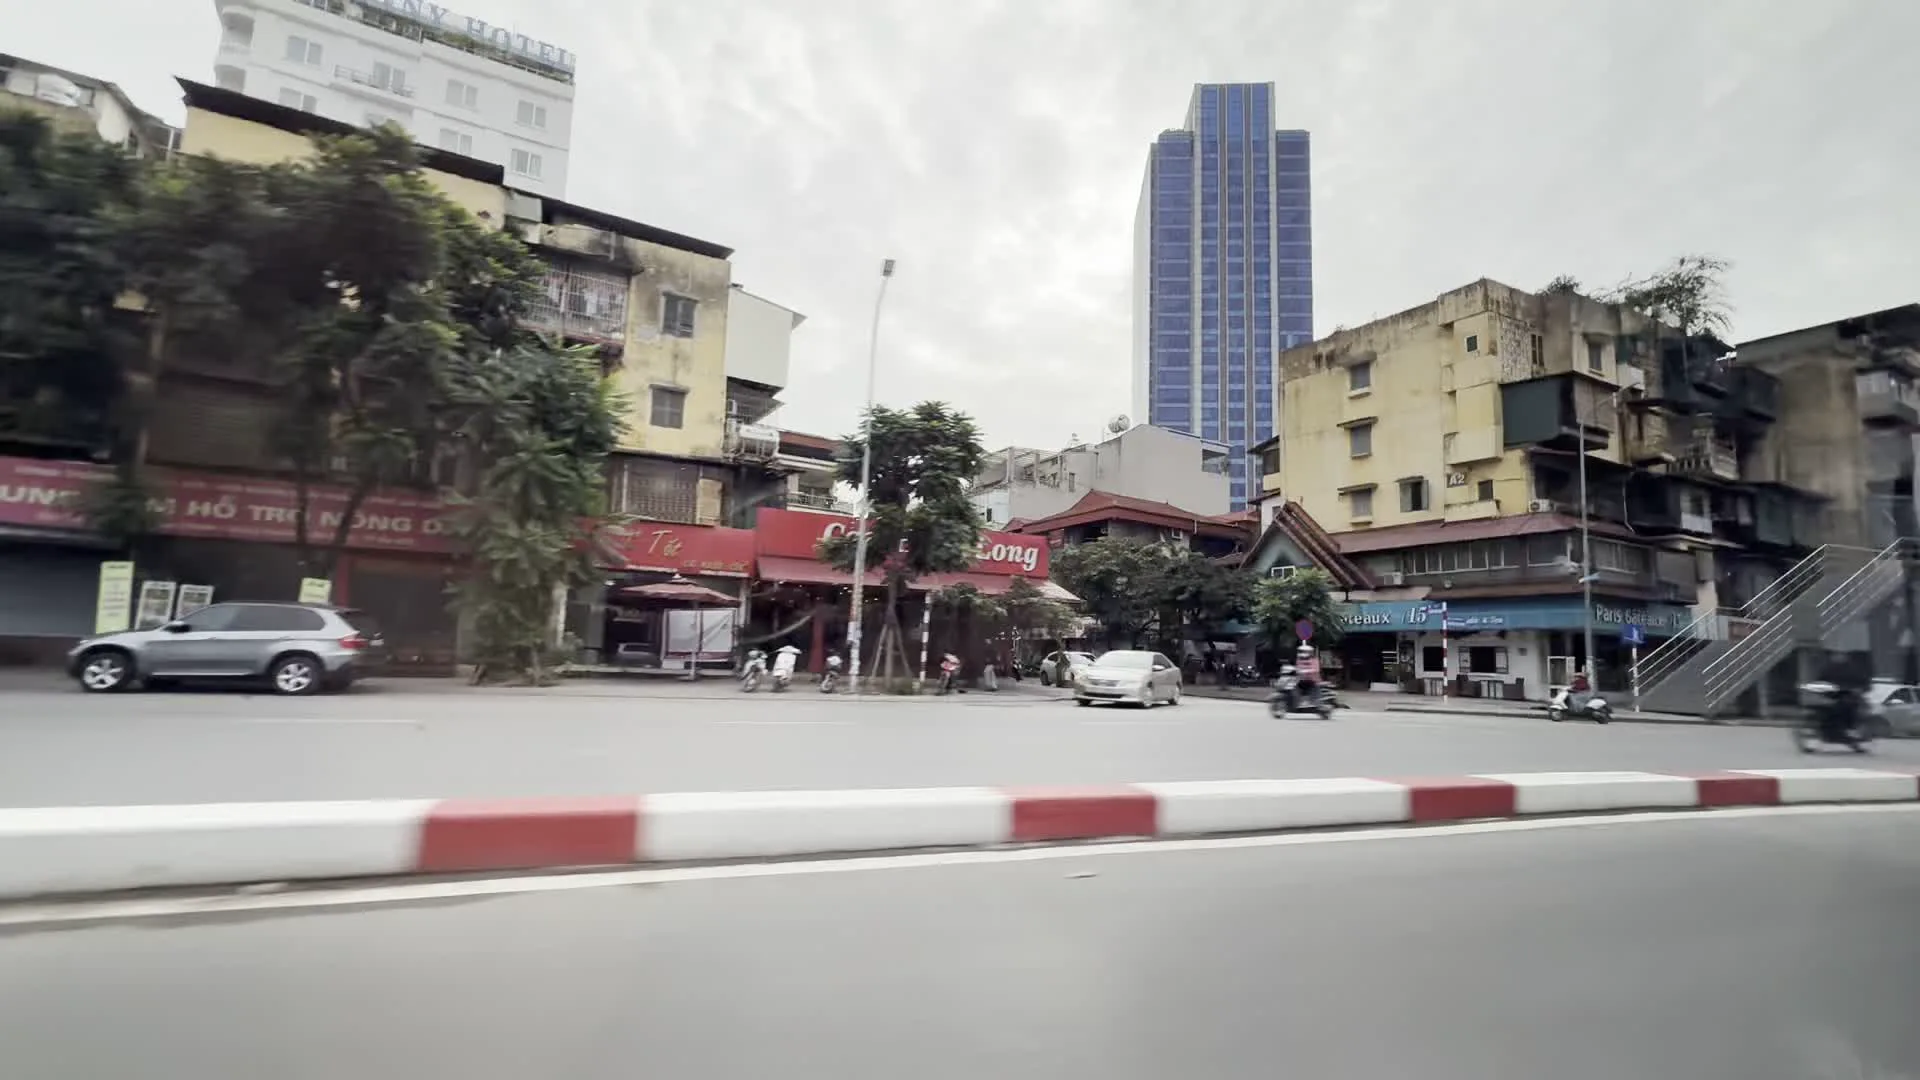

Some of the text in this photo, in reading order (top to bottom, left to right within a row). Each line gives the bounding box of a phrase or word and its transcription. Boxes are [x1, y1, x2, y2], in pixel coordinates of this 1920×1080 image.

[464, 15, 574, 68] HOTEL
[1449, 471, 1465, 486] A2
[0, 485, 81, 505] UN
[1596, 603, 1623, 624] Paris
